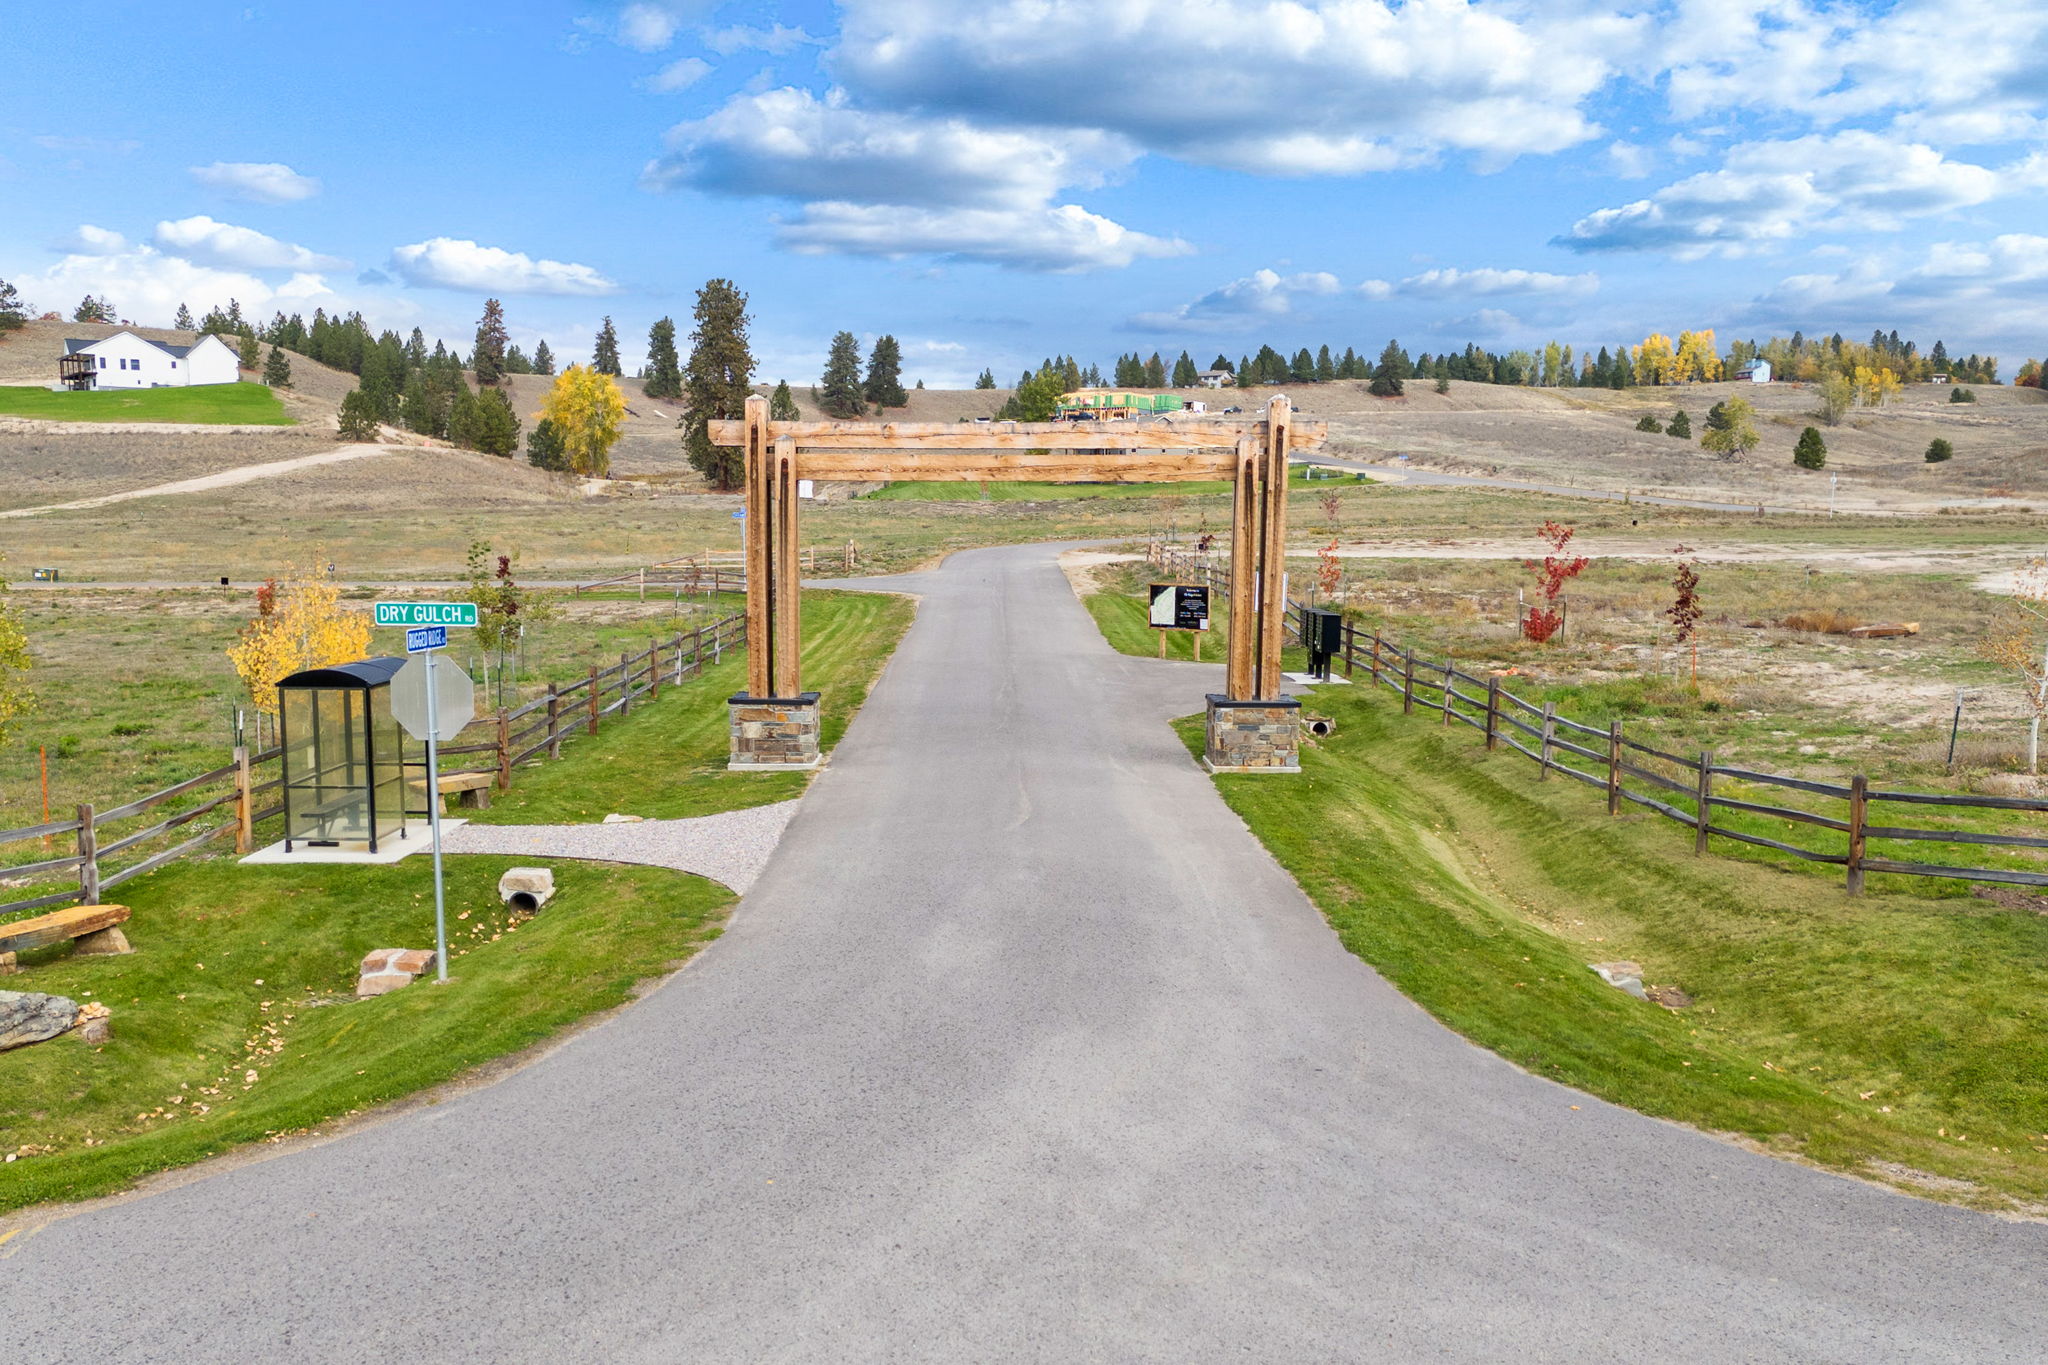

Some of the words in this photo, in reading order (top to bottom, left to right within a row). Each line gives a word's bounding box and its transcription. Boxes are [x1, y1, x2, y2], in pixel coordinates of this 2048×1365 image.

[380, 606, 408, 622] DRY
[413, 606, 461, 622] GULCH
[464, 615, 474, 623] RD
[408, 631, 428, 649] RUGGED
